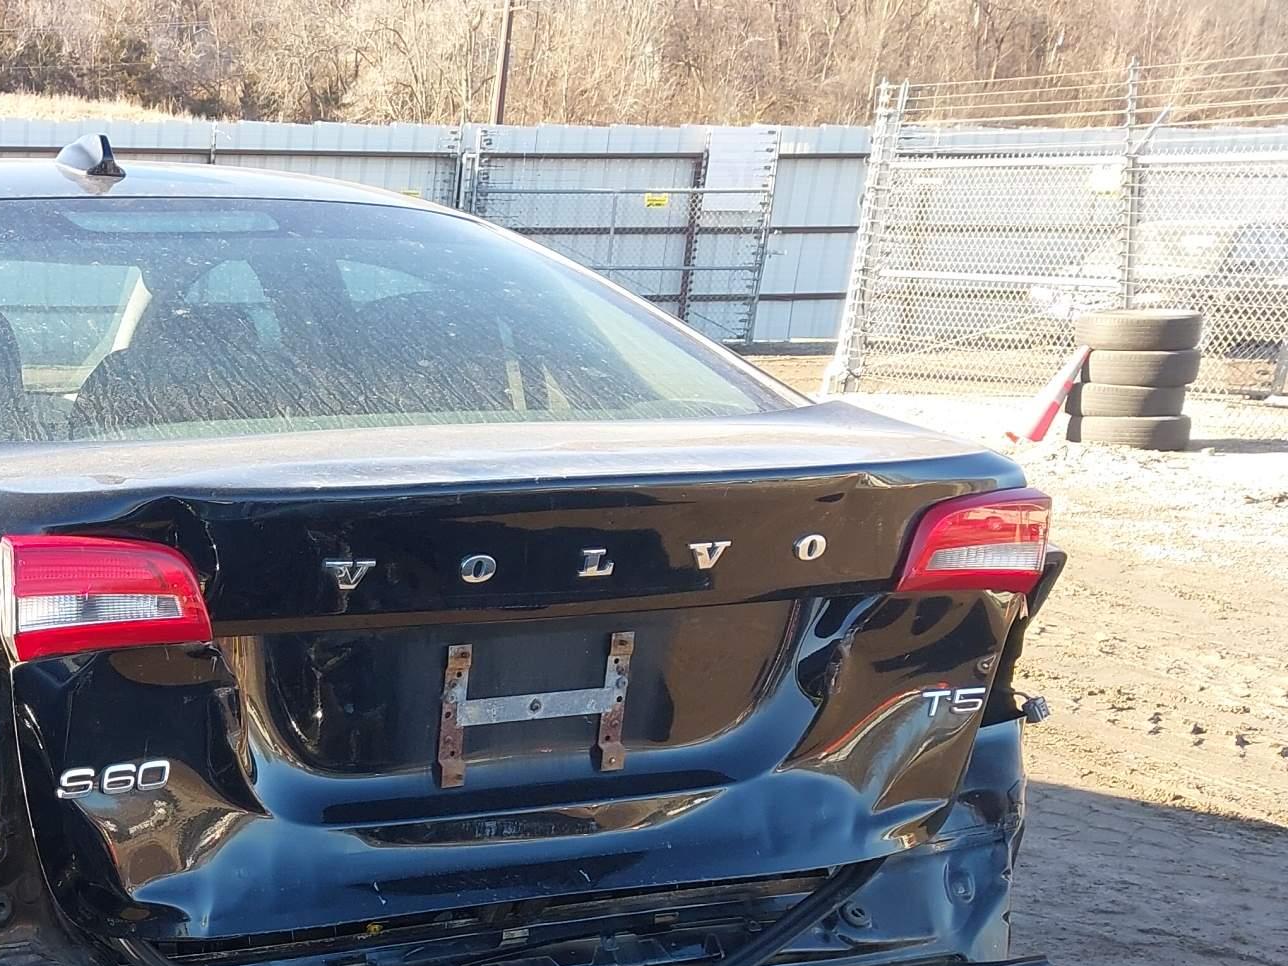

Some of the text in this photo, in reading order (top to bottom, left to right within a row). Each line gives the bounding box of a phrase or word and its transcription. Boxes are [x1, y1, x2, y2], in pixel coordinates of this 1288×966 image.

[325, 533, 829, 590] VOLVO
[922, 686, 987, 719] T5
[56, 759, 170, 799] S60
